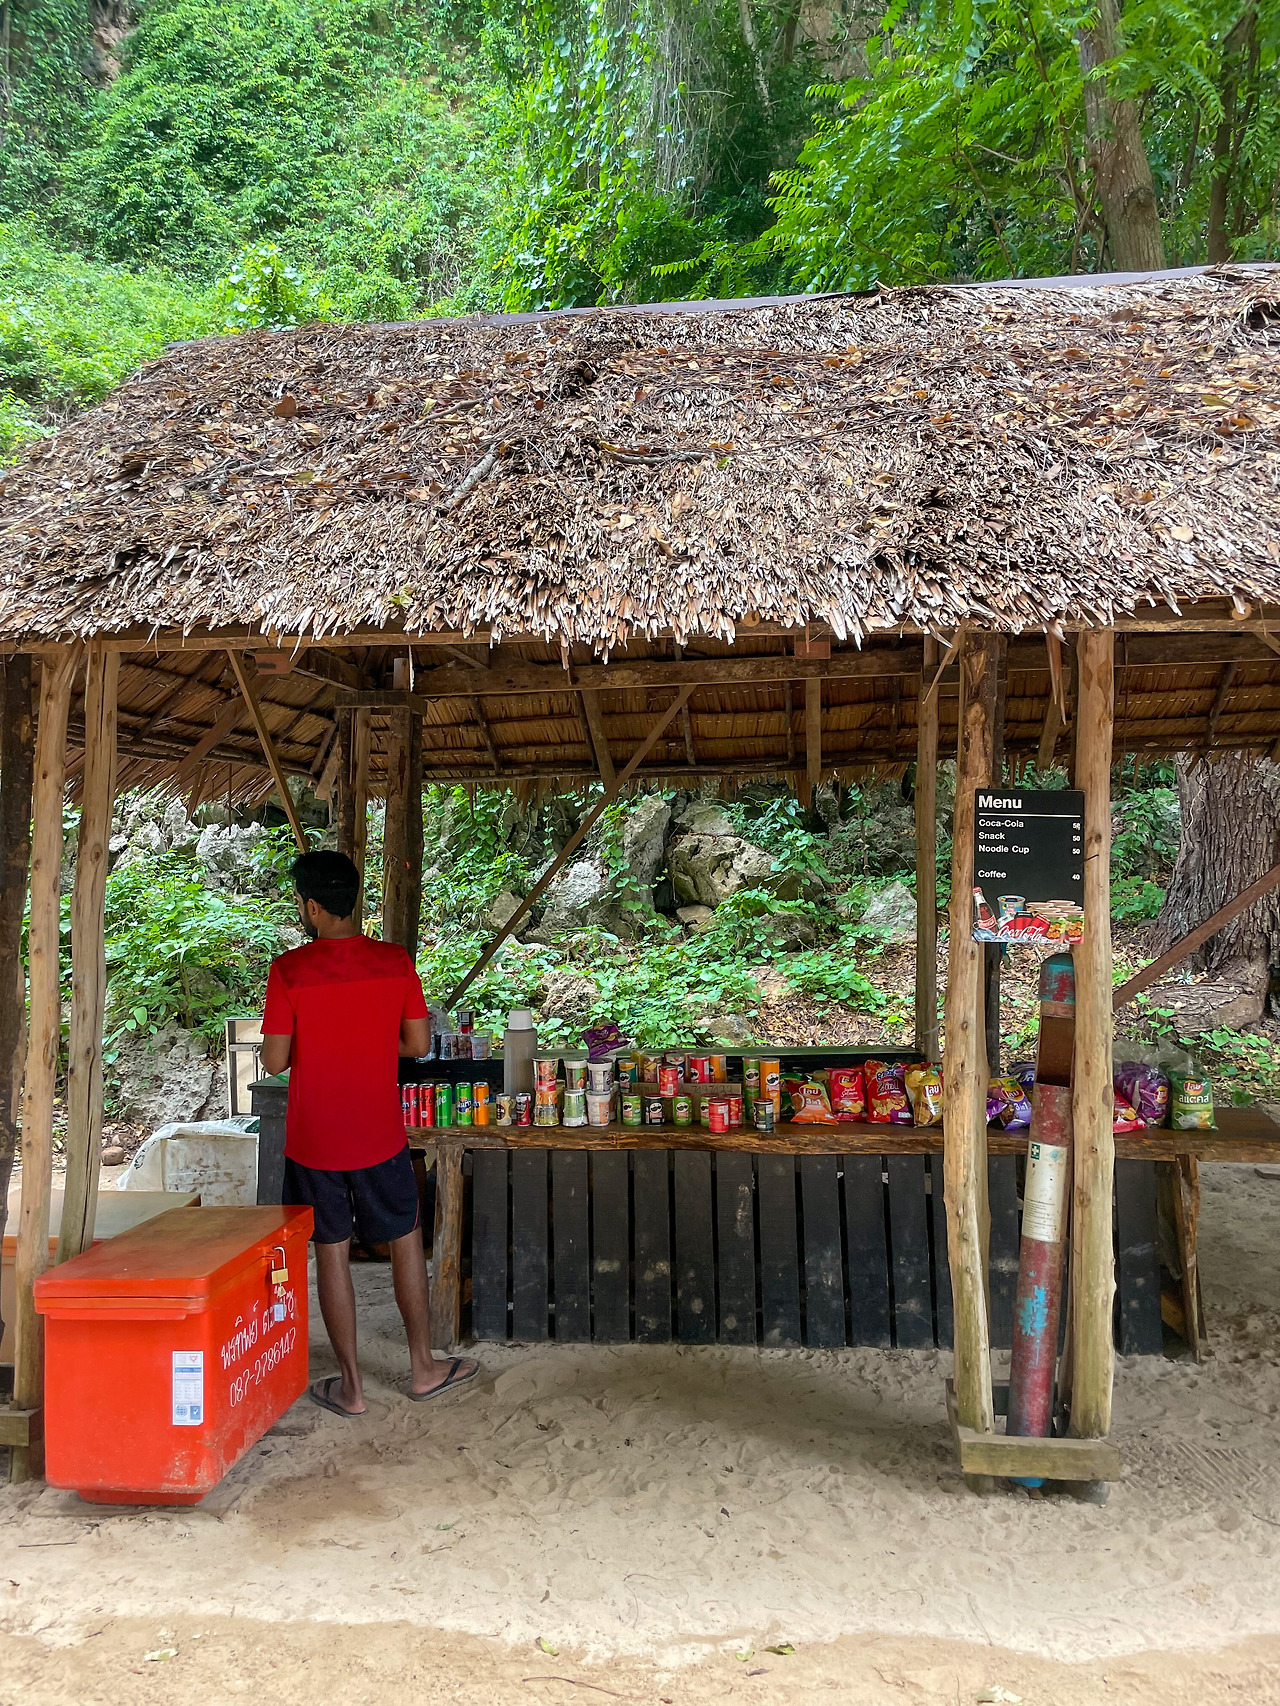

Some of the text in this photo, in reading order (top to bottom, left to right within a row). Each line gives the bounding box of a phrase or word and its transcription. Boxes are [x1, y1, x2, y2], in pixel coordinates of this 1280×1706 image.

[978, 795, 1022, 809] Menu
[978, 819, 1024, 828] Coca-Cola
[978, 832, 1006, 840] Snack
[978, 844, 1030, 855] Noodle Cup
[977, 869, 1007, 879] Coffee
[1071, 873, 1081, 881] 40
[229, 1326, 297, 1408] 087-2786147
